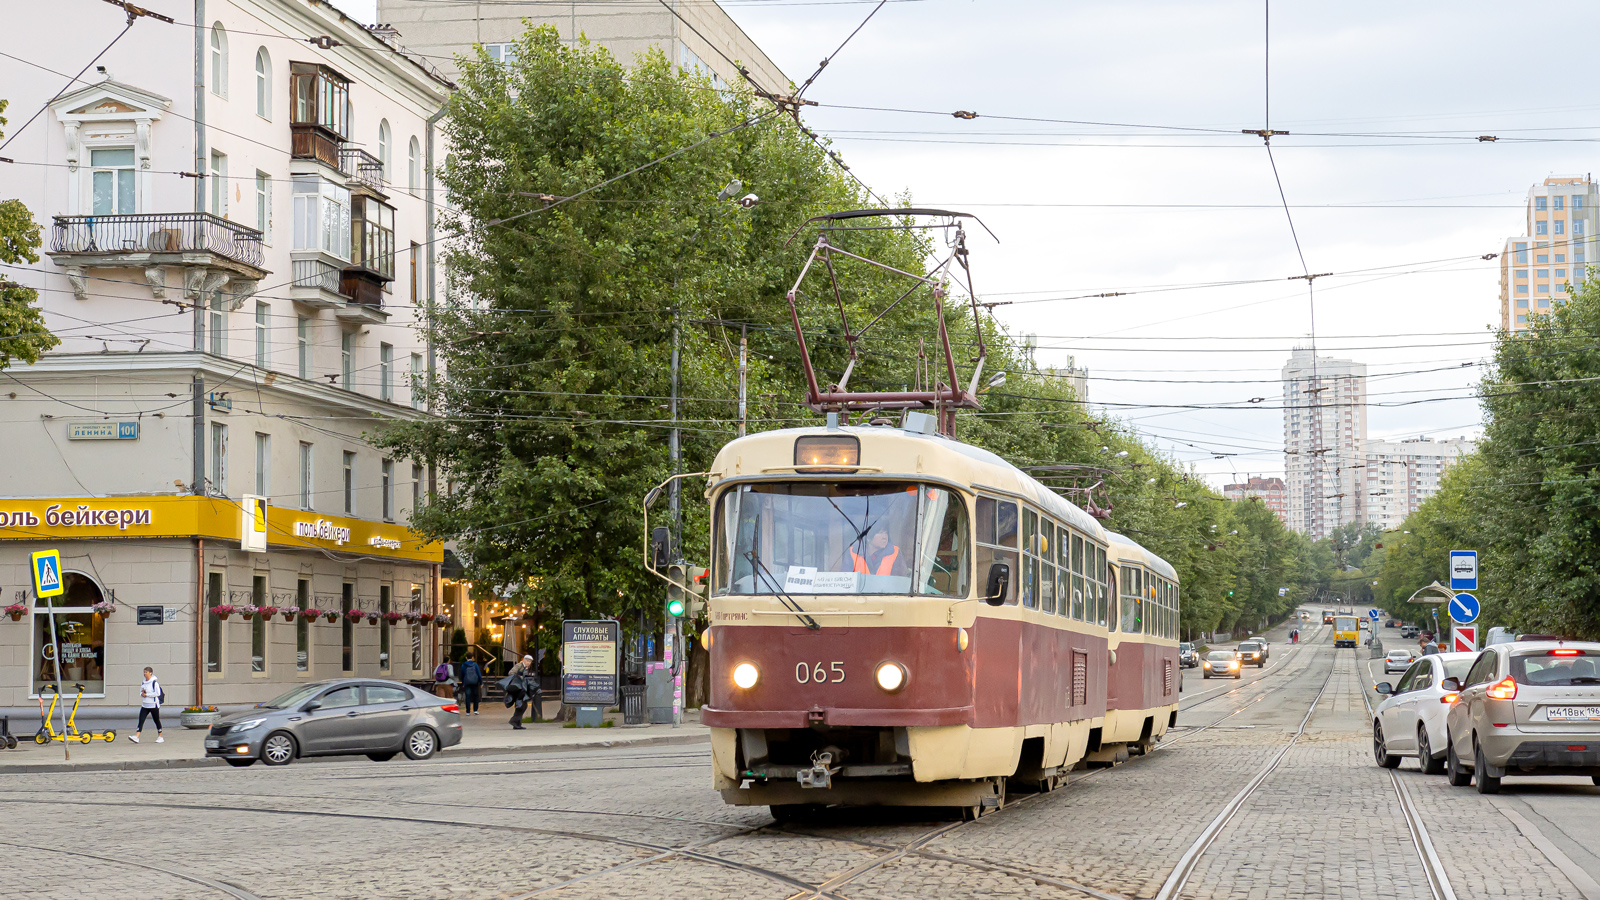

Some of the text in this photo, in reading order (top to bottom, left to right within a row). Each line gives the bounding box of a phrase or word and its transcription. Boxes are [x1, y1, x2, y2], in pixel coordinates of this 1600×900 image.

[121, 425, 135, 435] 101
[45, 504, 152, 530] бейкери
[788, 577, 813, 585] парк
[573, 626, 608, 634] СЛУХОВЫЕ
[795, 661, 846, 684] 065
